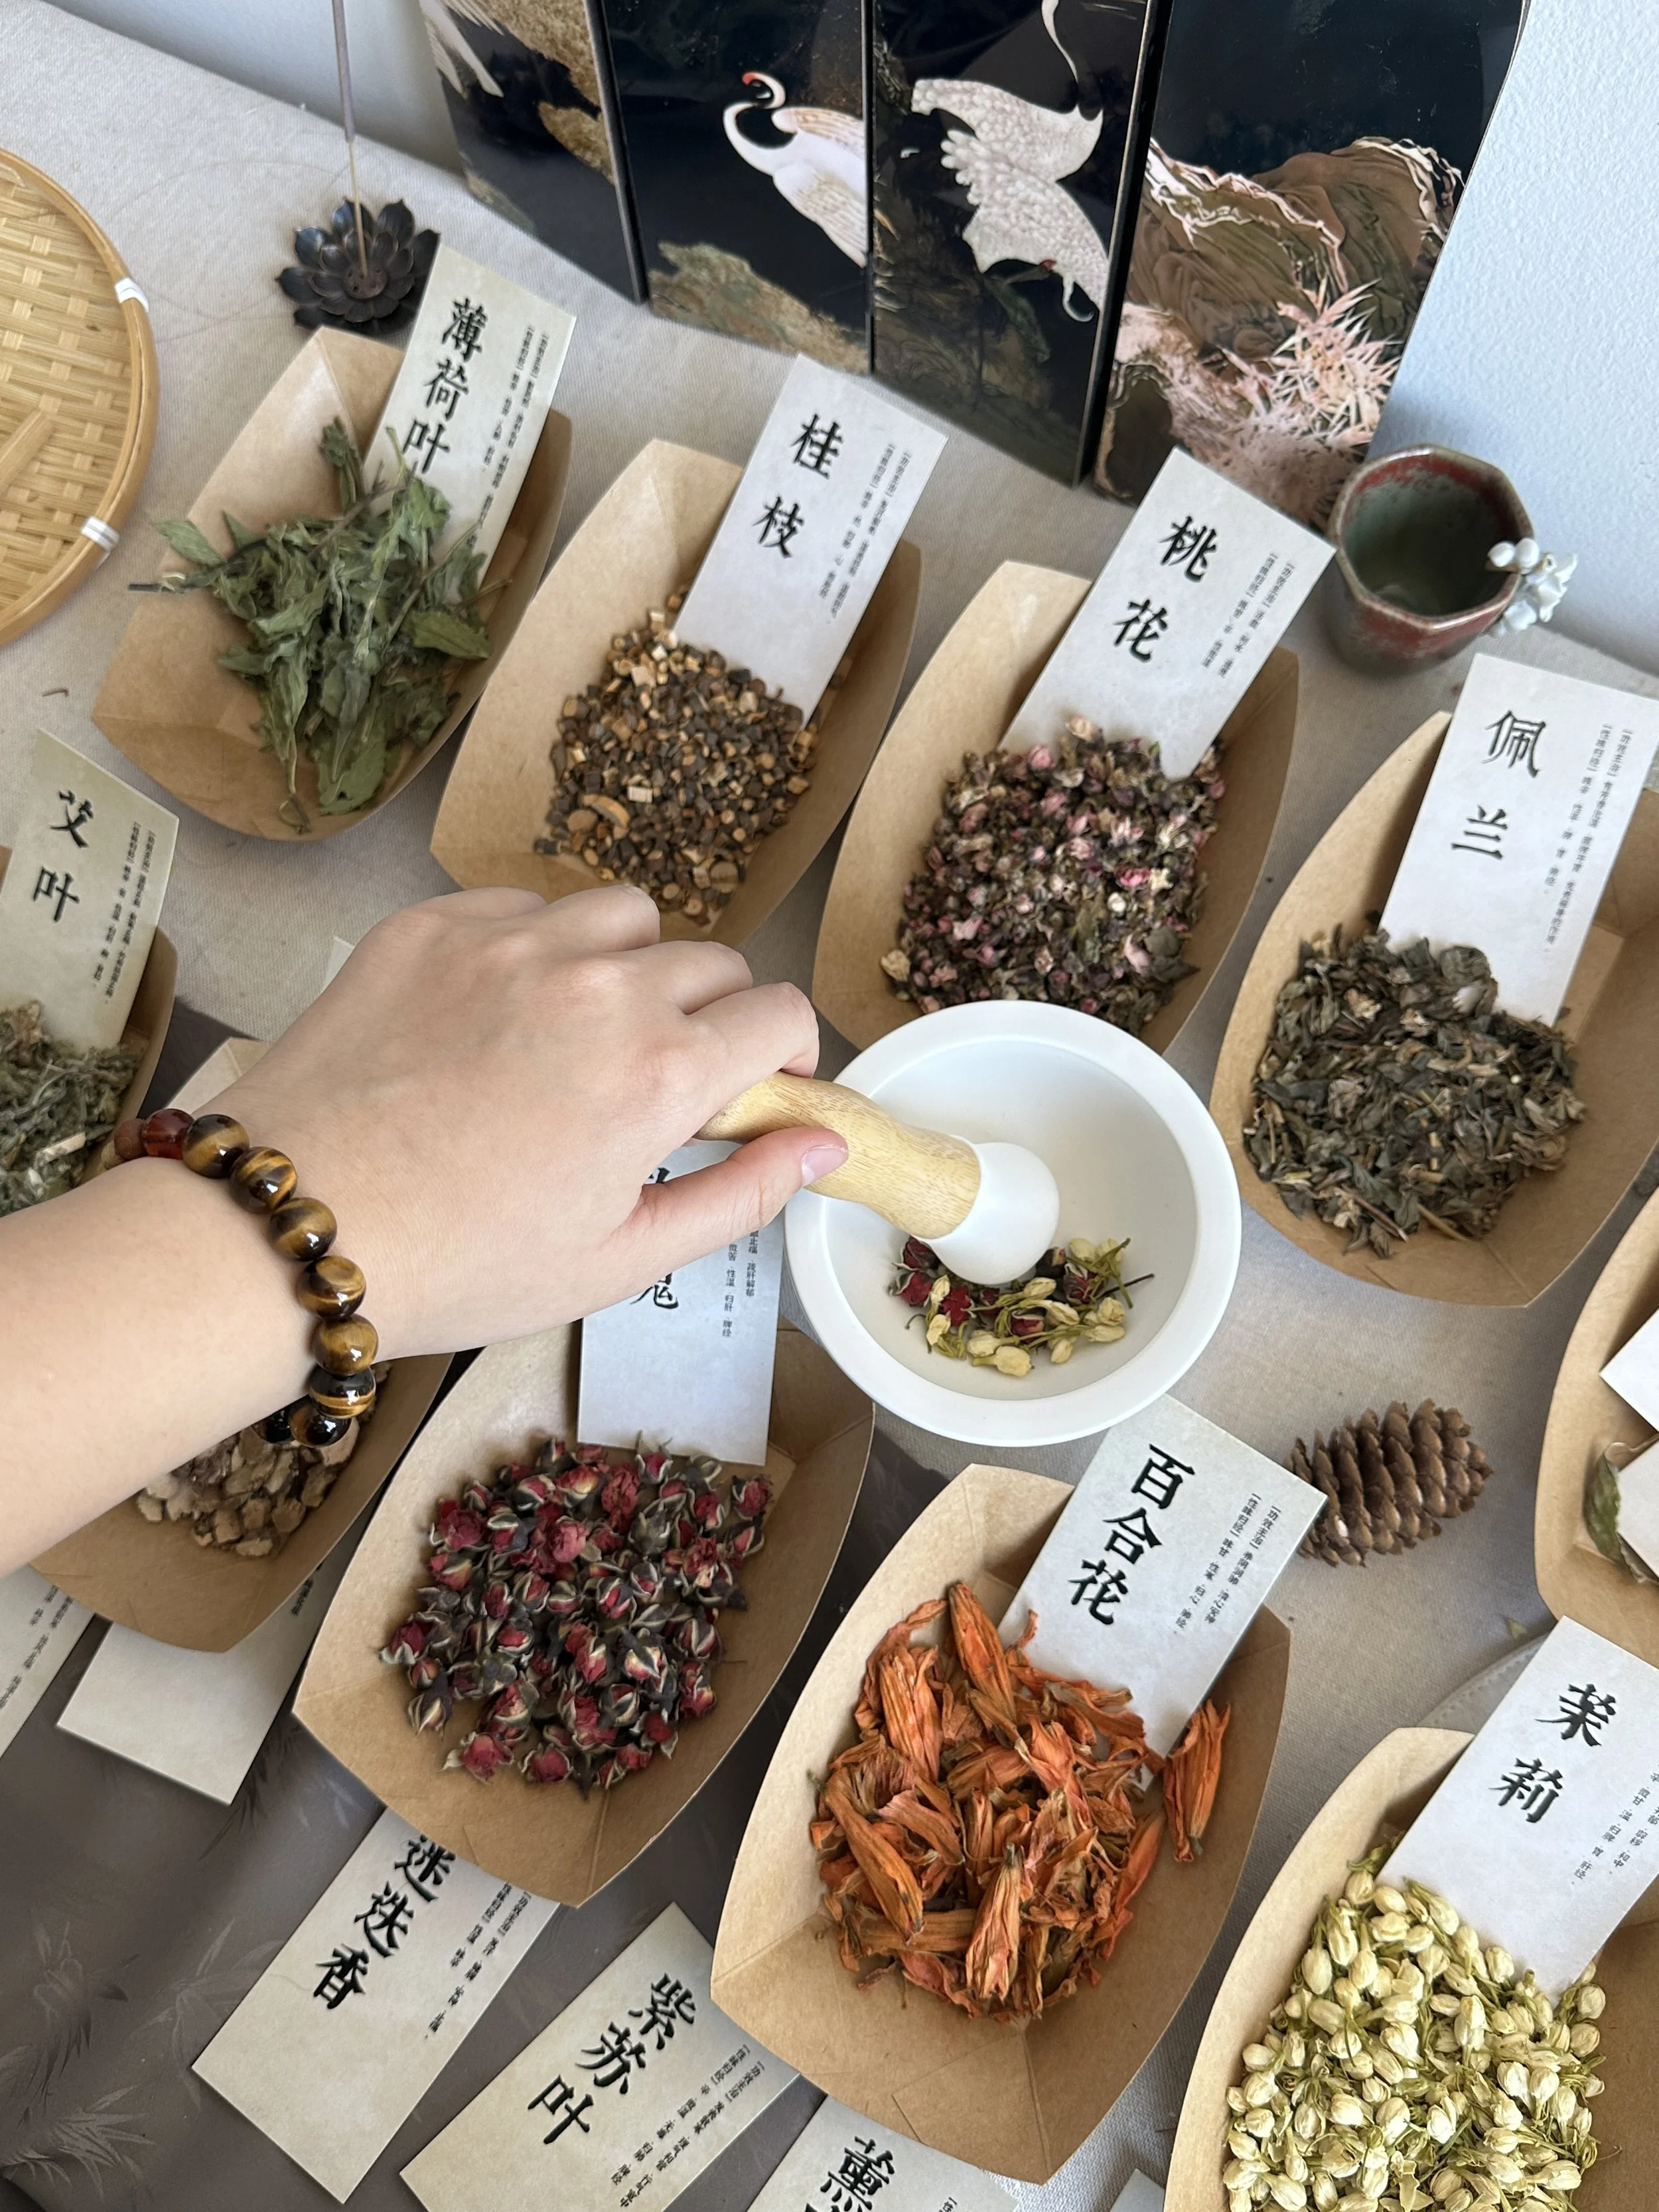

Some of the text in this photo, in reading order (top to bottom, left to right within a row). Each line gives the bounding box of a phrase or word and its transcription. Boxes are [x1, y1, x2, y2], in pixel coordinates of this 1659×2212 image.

[401, 297, 487, 474] 薄荷叶
[753, 413, 843, 557] 桂枝
[1114, 516, 1216, 662] 桃花
[33, 790, 93, 922] 艾叶
[1451, 711, 1546, 859] 佩兰
[1068, 1444, 1195, 1625] 百合花
[1492, 1684, 1616, 1823] 茉莉
[313, 1834, 457, 2010] 迷迭香
[528, 1972, 696, 2144] 紫苏叶
[805, 2136, 895, 2212] 薰
